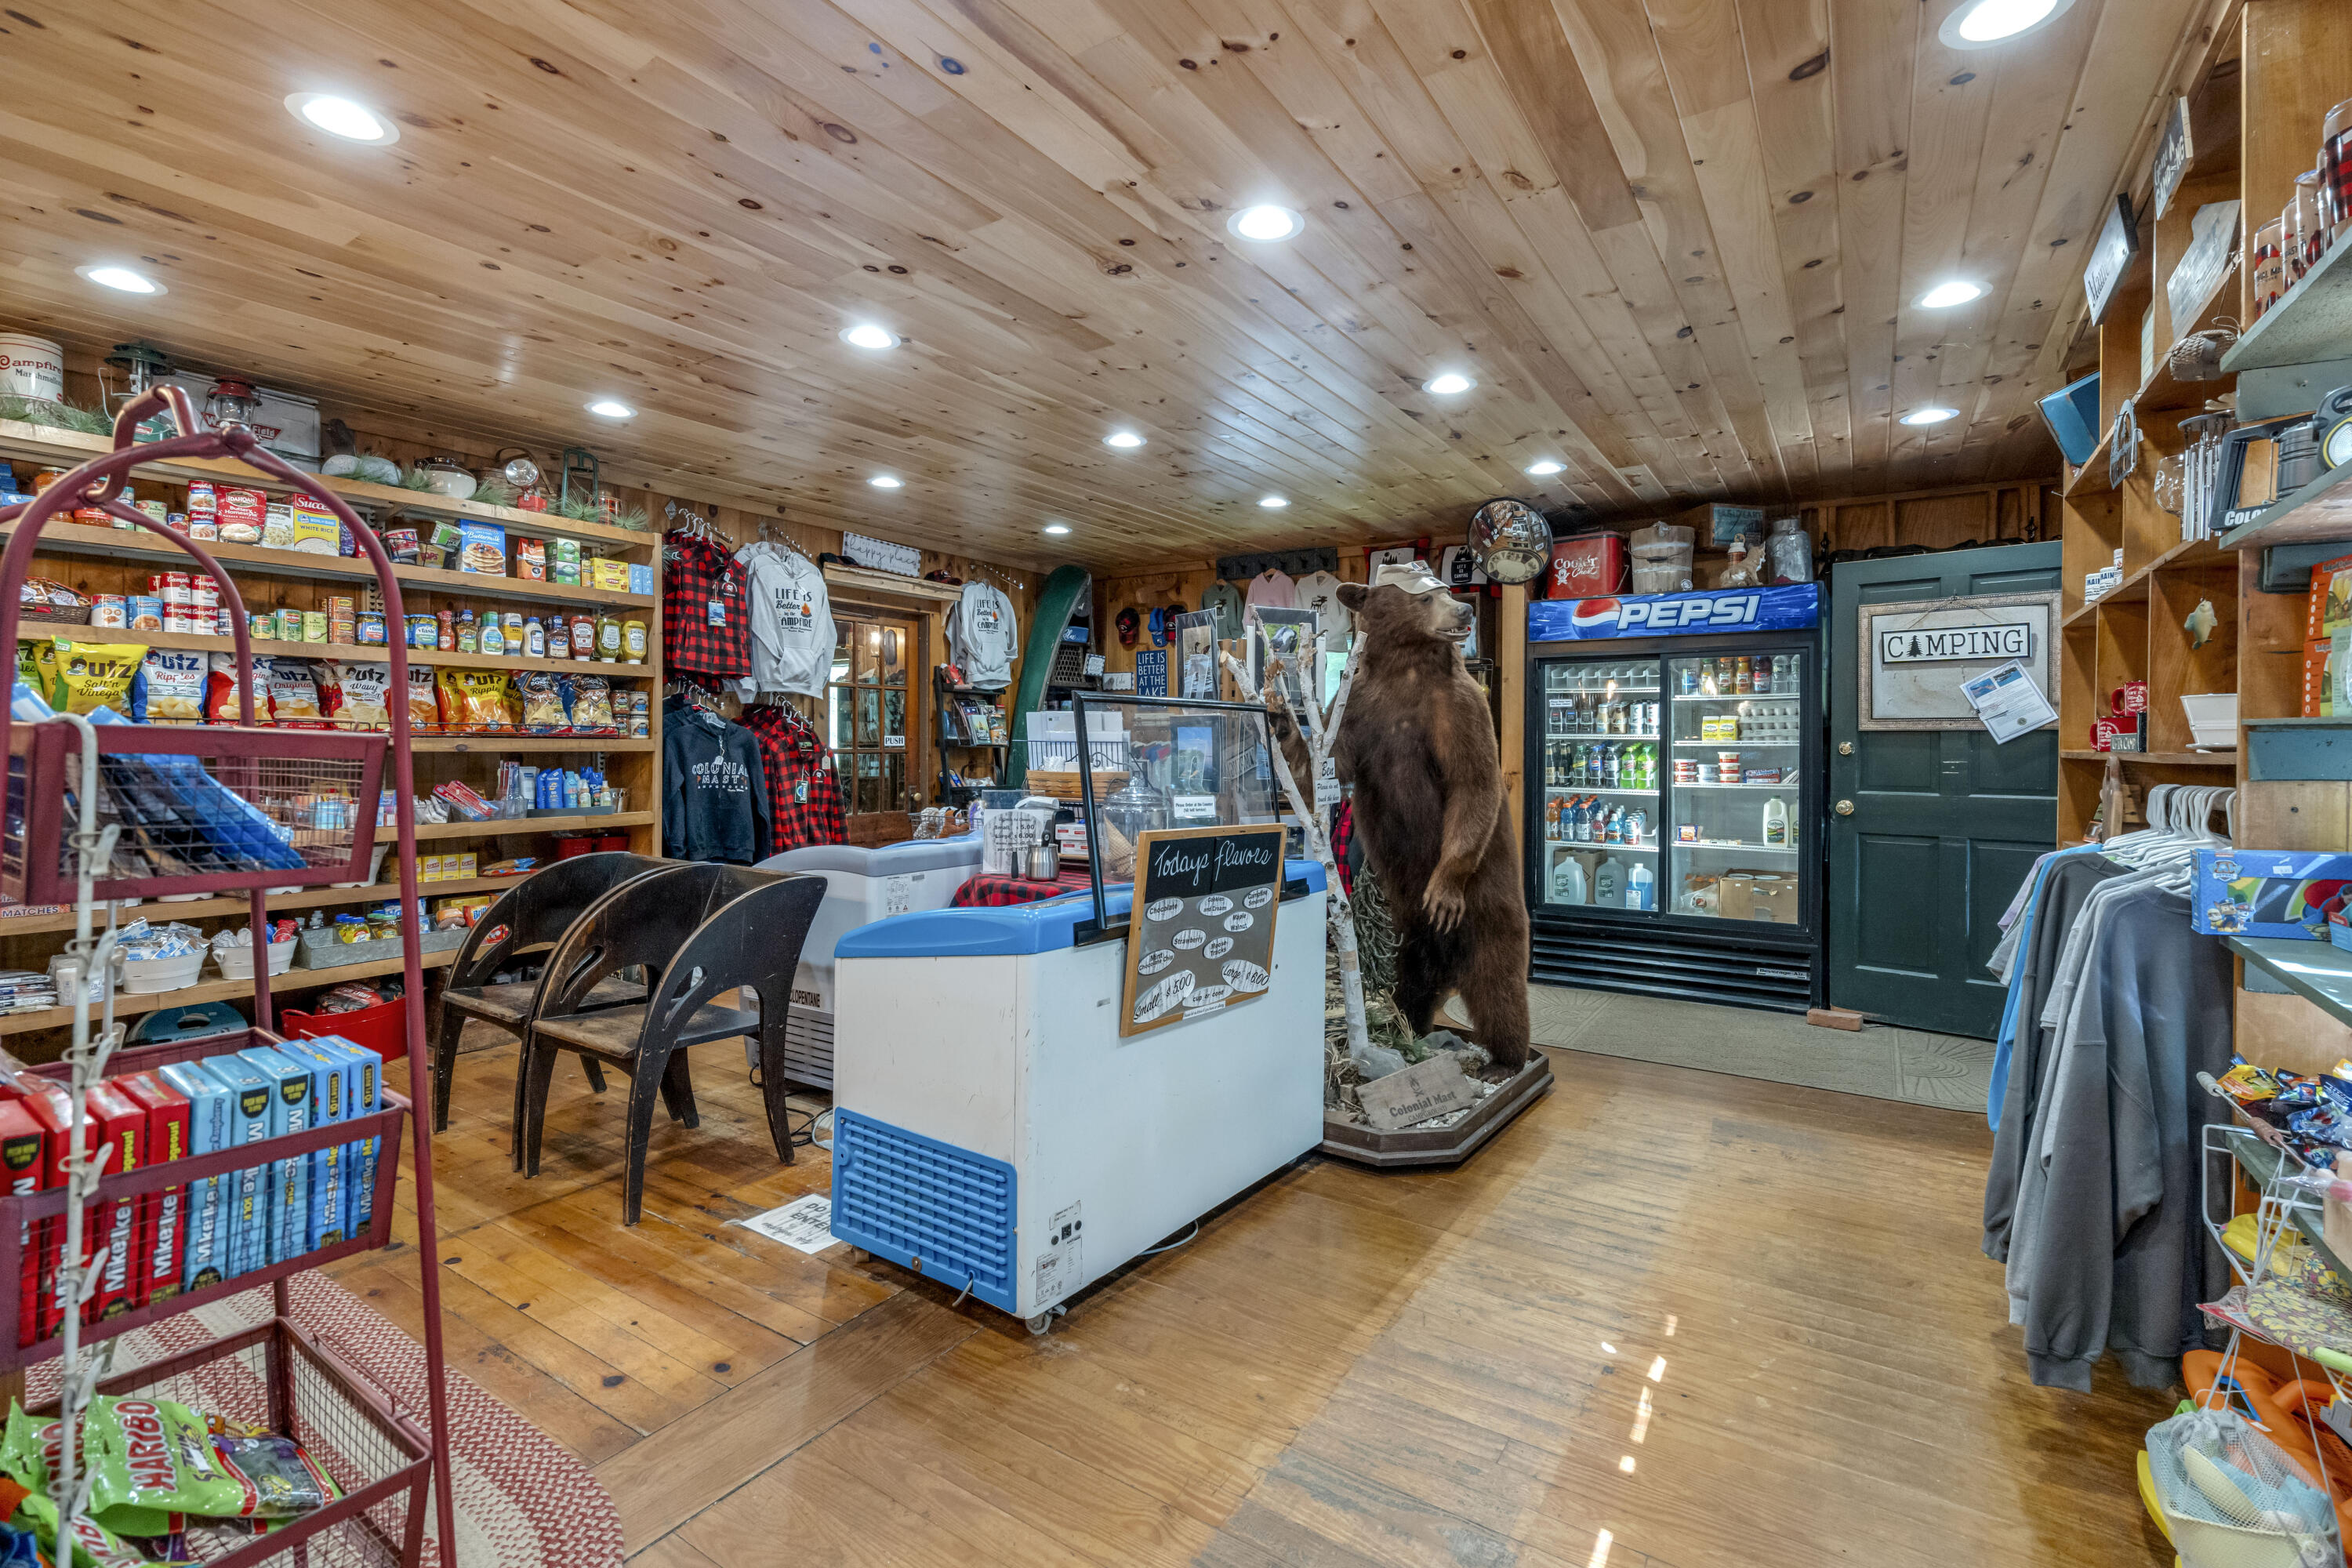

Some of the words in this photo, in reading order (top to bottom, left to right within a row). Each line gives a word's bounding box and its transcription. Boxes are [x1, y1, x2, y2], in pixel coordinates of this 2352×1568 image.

[0, 355, 62, 374] Campfire
[224, 510, 258, 518] Homestyle
[466, 531, 500, 542] Buttermilk
[775, 587, 800, 601] LIFE
[803, 591, 812, 602] IS
[775, 600, 800, 610] Better
[977, 598, 991, 609] LIFE
[992, 600, 1000, 610] IS
[1617, 593, 1761, 630] PEPSI
[779, 616, 812, 628] AMPFIRE
[1138, 653, 1155, 665] LIFE
[1157, 652, 1165, 664] IS
[1138, 664, 1166, 676] BETTER
[1139, 677, 1149, 687] AT
[1150, 675, 1166, 685] THE
[350, 683, 378, 695] Wavy
[1138, 686, 1167, 697] LAKE
[691, 761, 749, 778] COLONIAL
[702, 775, 740, 784] MAST
[1155, 844, 1209, 886] Todays
[2, 906, 59, 918] MATCHES
[1149, 902, 1178, 915] Chocolate
[1232, 913, 1247, 921] Maple
[1174, 935, 1203, 946] Strawberry
[1210, 946, 1227, 956] Tracks
[1138, 958, 1163, 971] Chocolate
[1163, 953, 1174, 963] Chip
[1150, 952, 1163, 963] Mint
[1223, 965, 1241, 985] Large
[1134, 994, 1160, 1021] Small
[365, 1068, 373, 1096] FLAVORS
[330, 1076, 339, 1104] FLAVORS
[331, 1104, 338, 1113] 10
[1389, 1097, 1433, 1118] Colonial
[1432, 1091, 1457, 1105] Mast
[1407, 1105, 1448, 1123] CAMPGROUND
[209, 1098, 225, 1143] Raspberry
[806, 1203, 827, 1212] DO
[789, 1212, 832, 1232] ENTER
[114, 1401, 177, 1493] HARIBO
